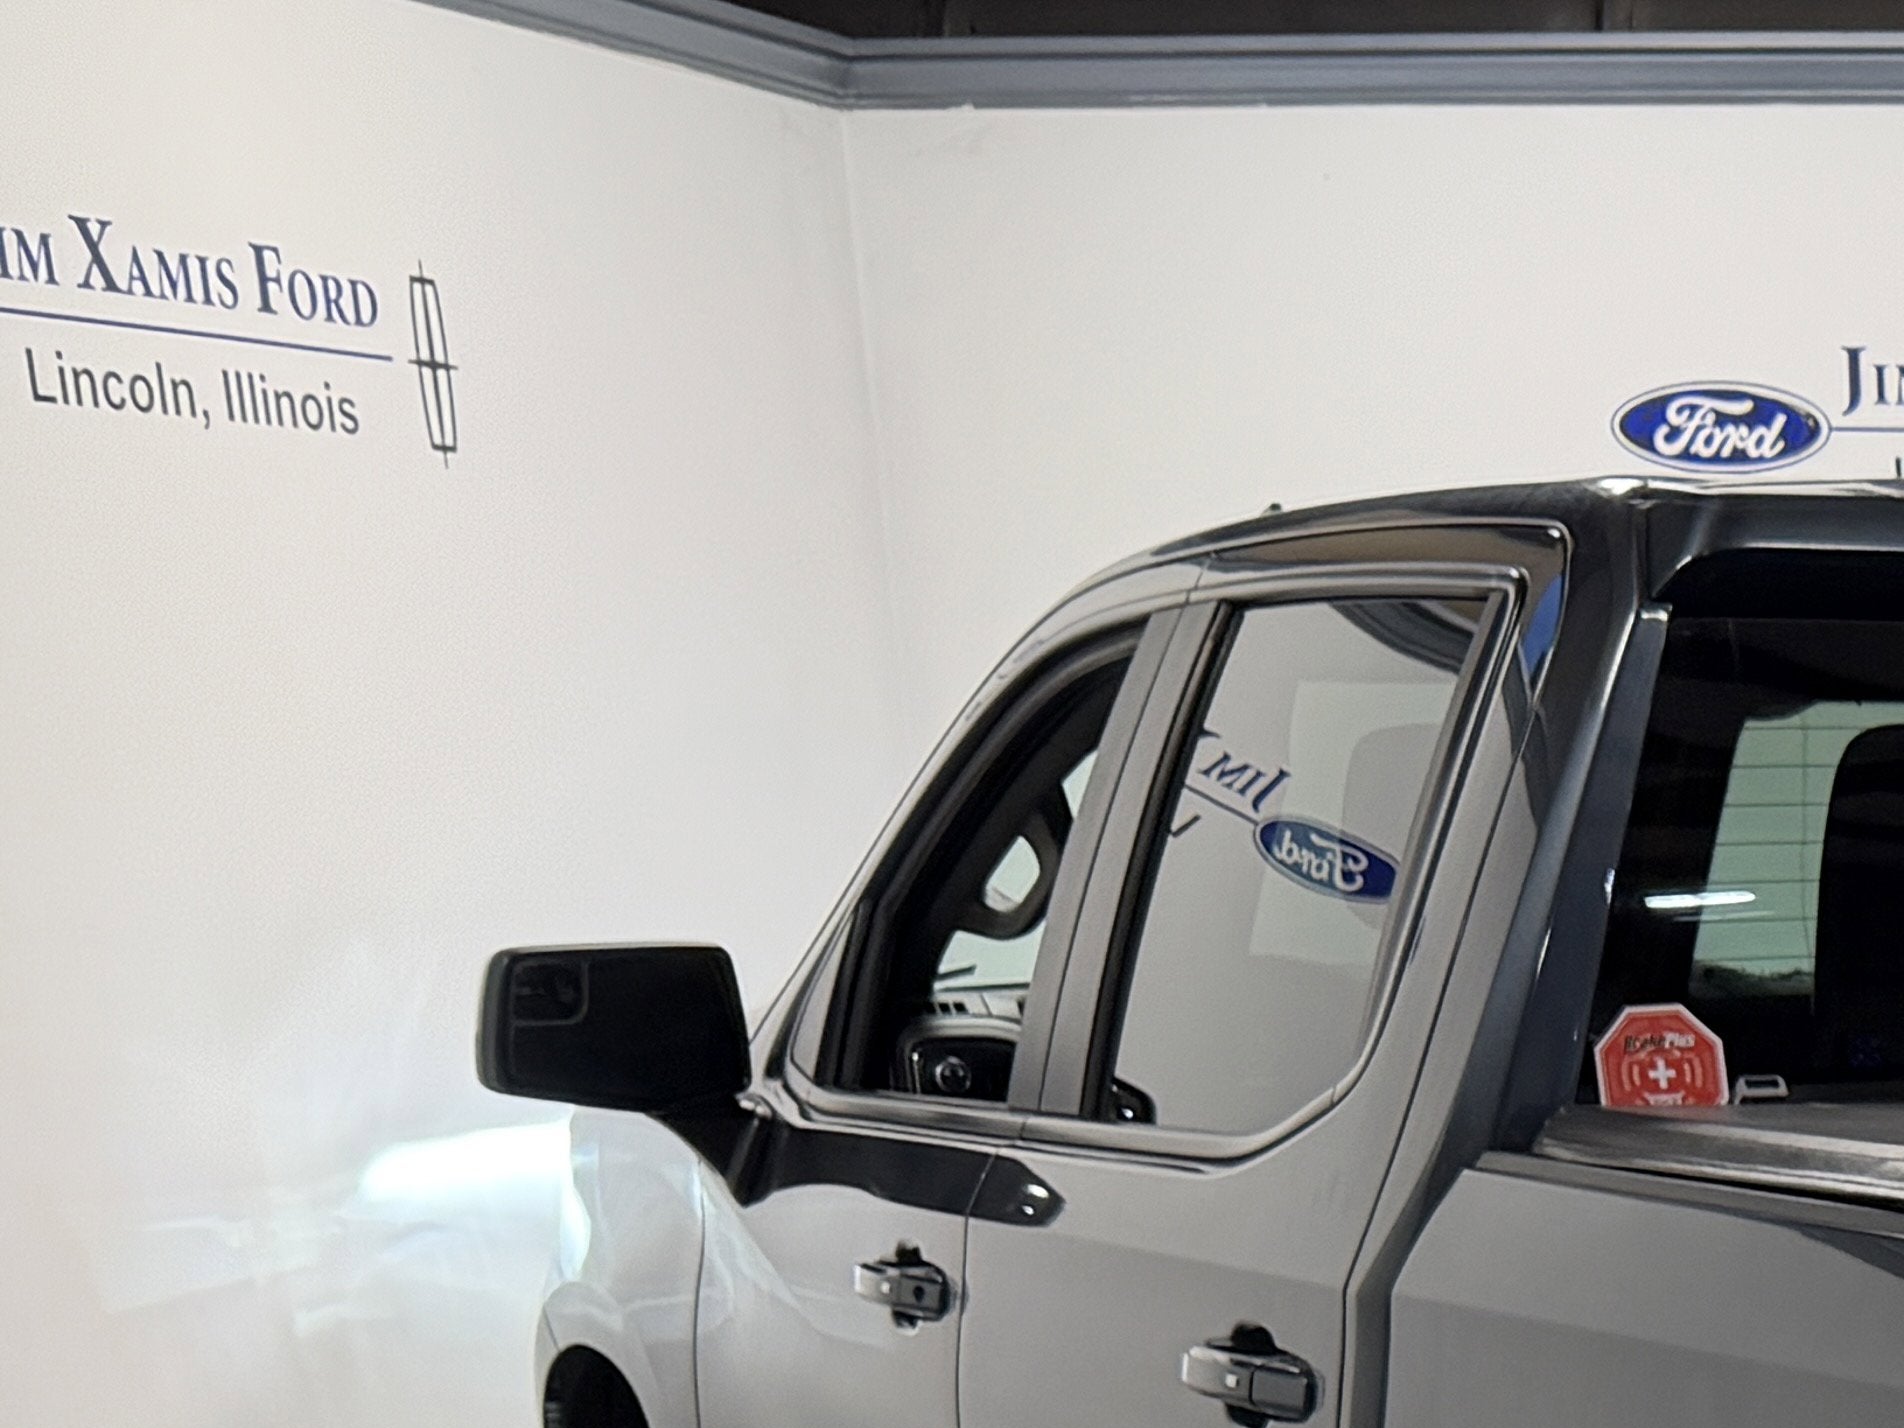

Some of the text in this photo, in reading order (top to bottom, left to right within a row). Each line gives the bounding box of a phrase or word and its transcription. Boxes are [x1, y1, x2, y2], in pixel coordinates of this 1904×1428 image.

[0, 213, 379, 328] IM XAMIS FORD
[25, 347, 360, 435] Lincoln, Illinois
[1652, 397, 1786, 459] Ford
